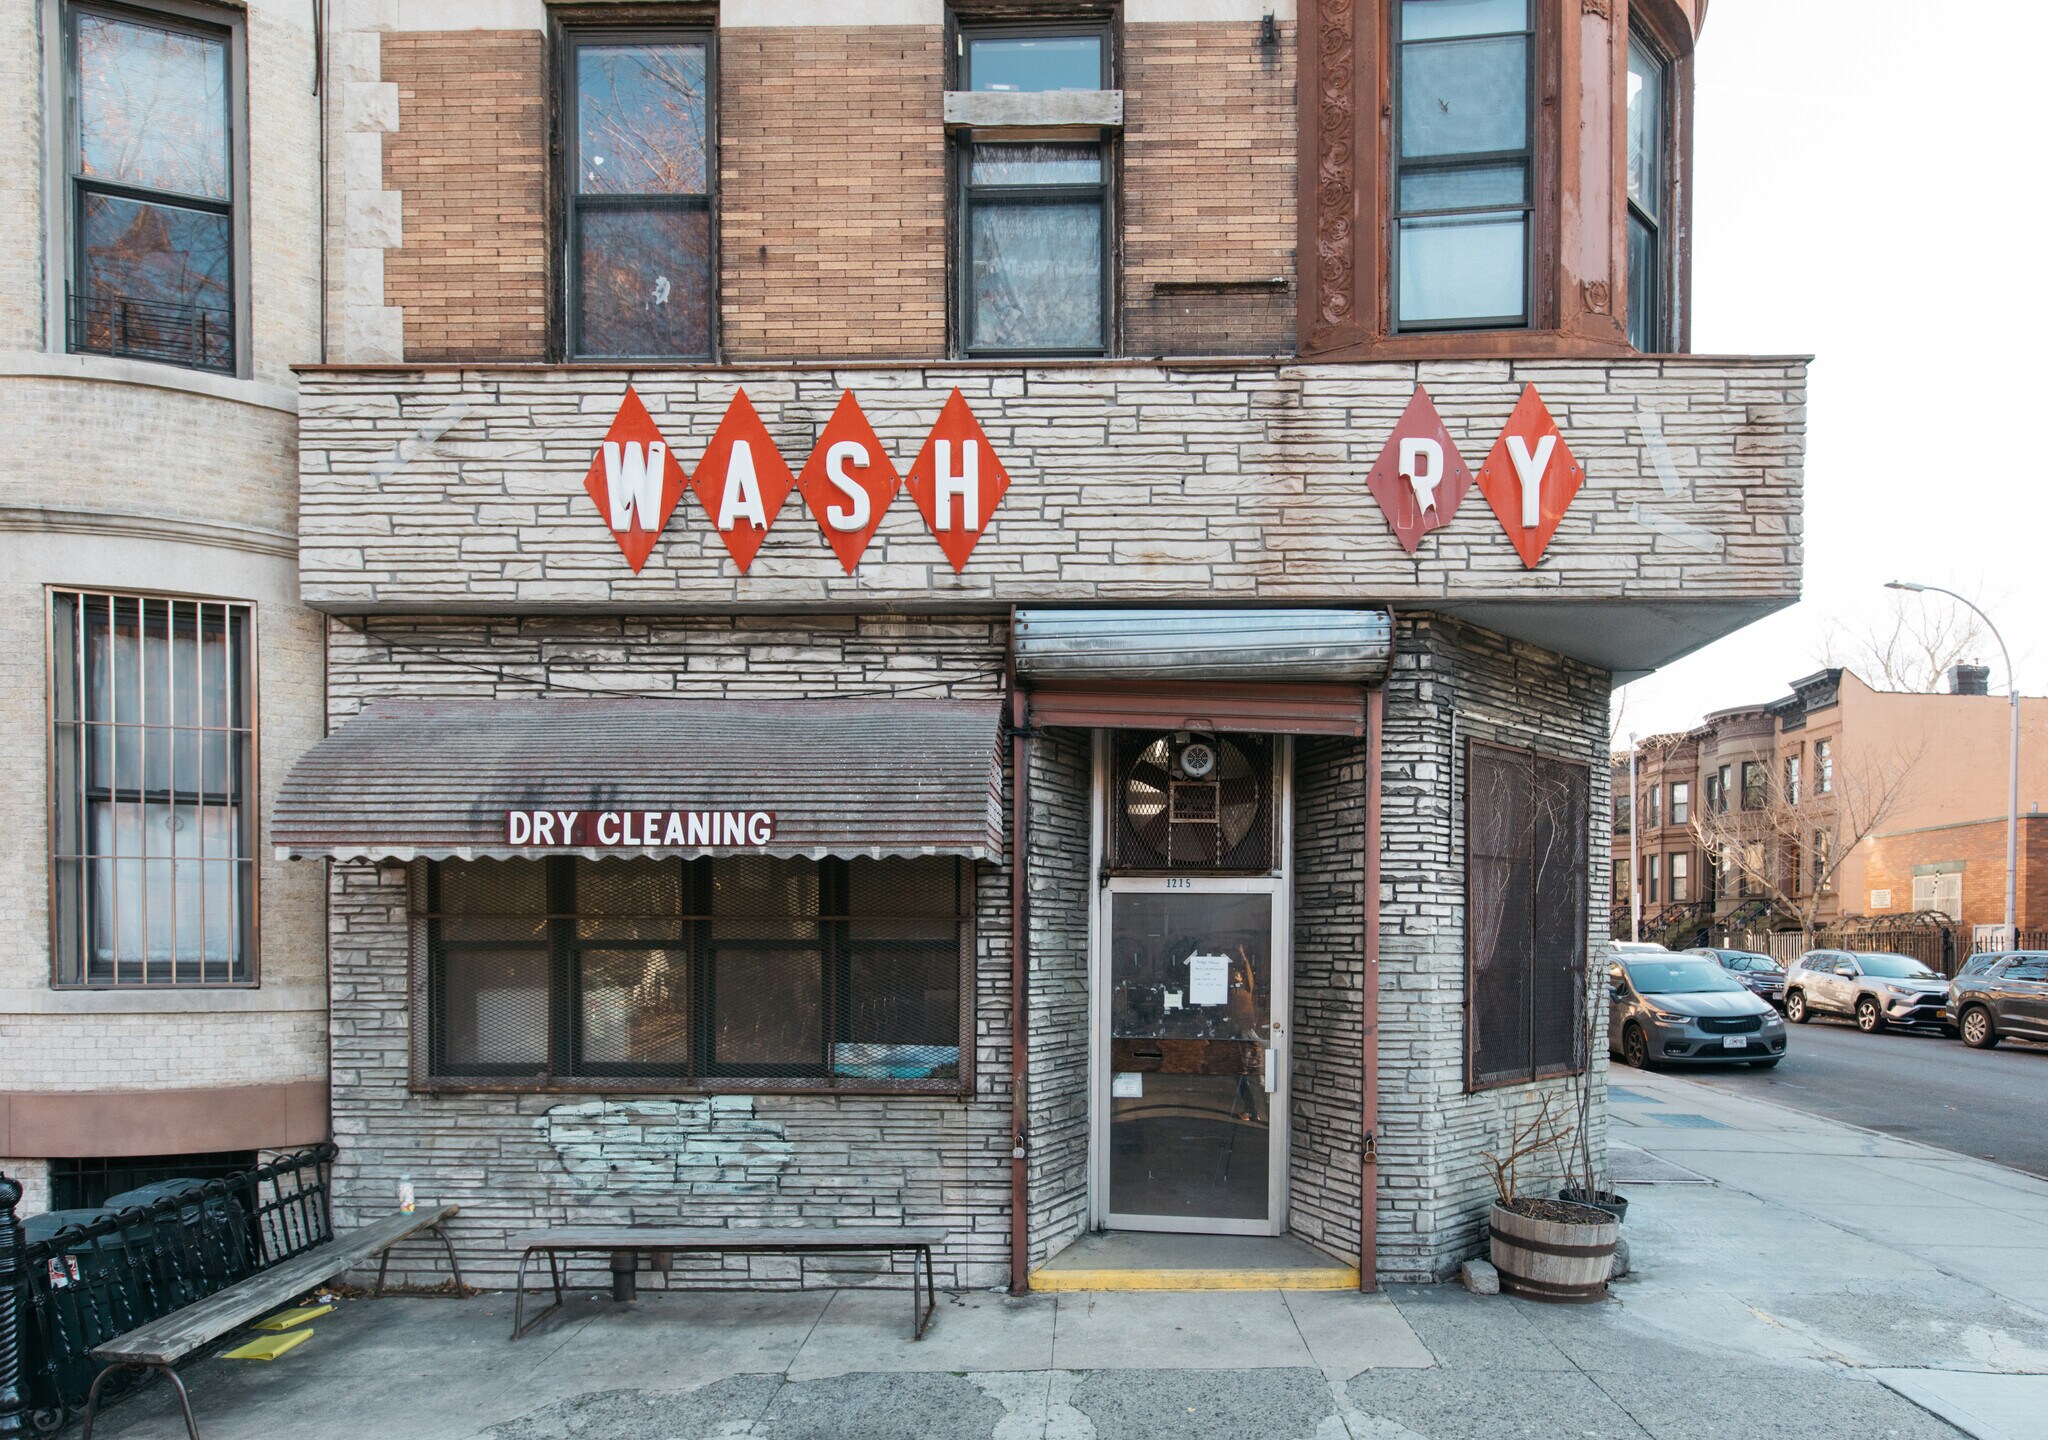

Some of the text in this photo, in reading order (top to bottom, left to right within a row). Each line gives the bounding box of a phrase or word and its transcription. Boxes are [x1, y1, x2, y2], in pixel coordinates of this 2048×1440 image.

[602, 439, 979, 533] WASH
[509, 811, 772, 846] DRY CLEANING
[1166, 878, 1191, 888] 1215
